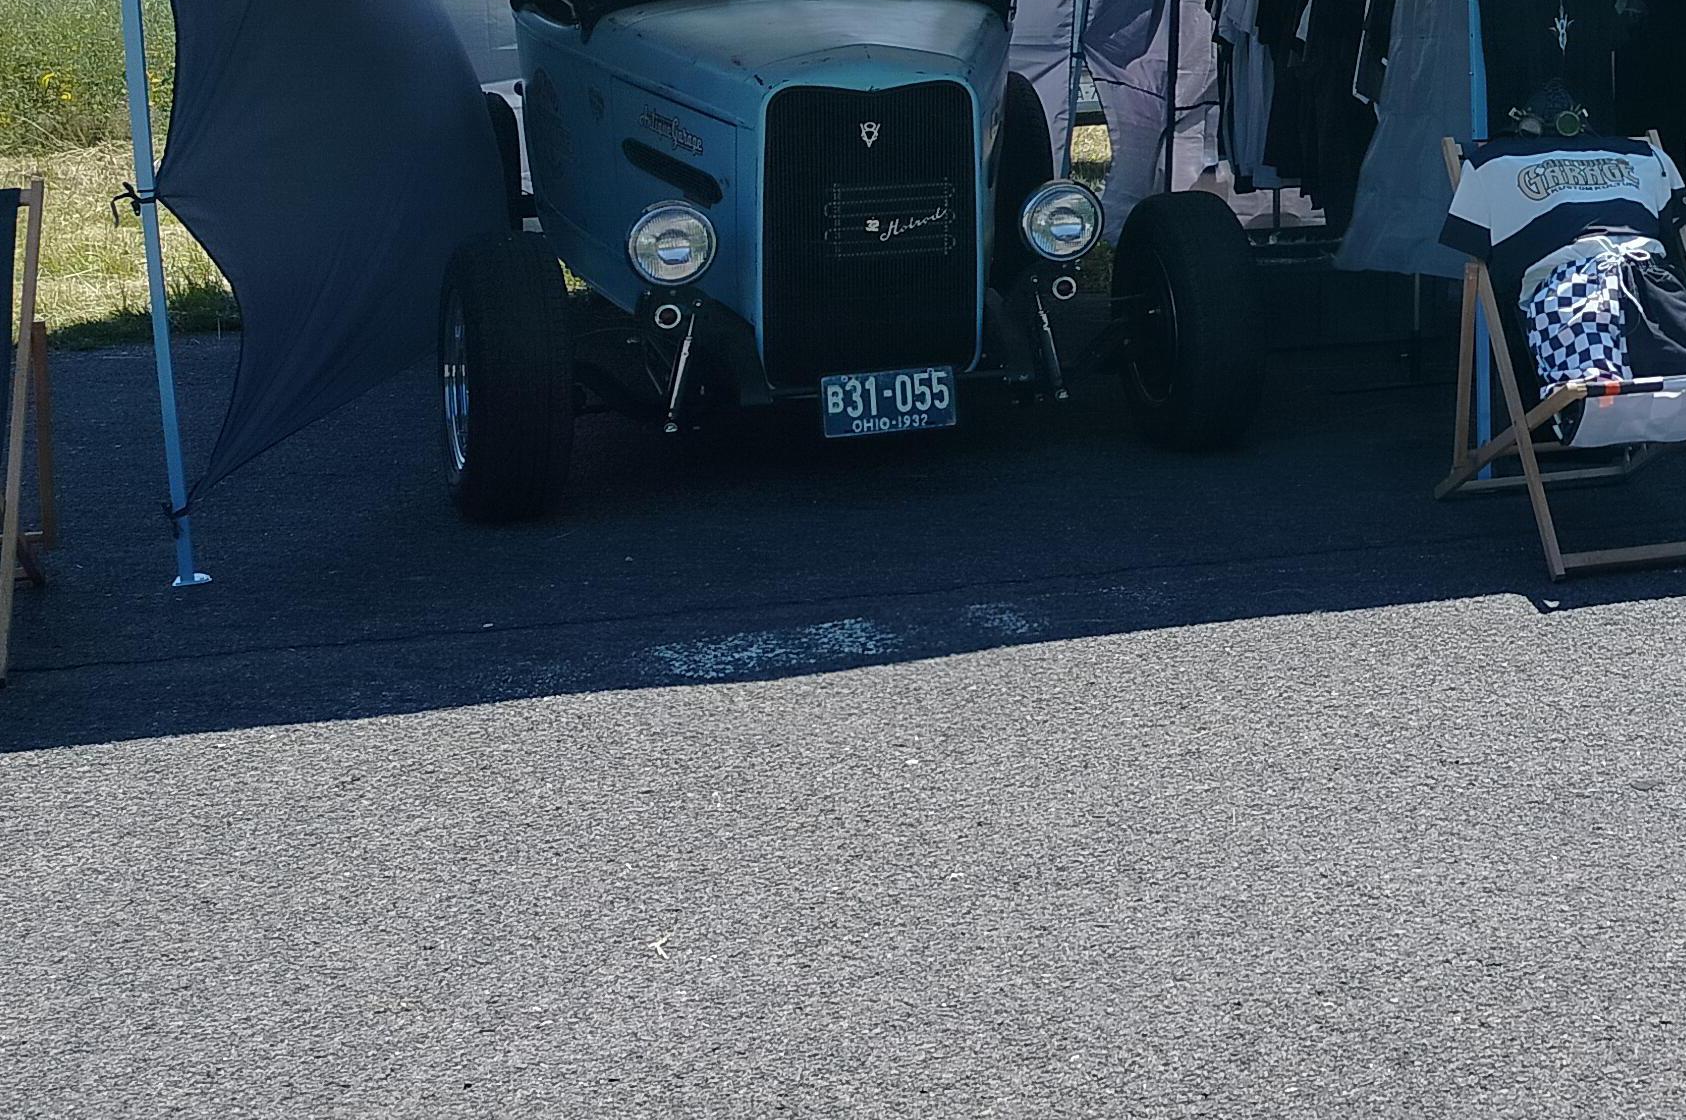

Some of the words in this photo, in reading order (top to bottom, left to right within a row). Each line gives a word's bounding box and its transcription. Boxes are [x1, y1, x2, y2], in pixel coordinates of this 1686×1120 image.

[1517, 162, 1640, 201] GARAGE
[827, 371, 950, 418] B31-055
[852, 414, 928, 433] OHIO-1932
